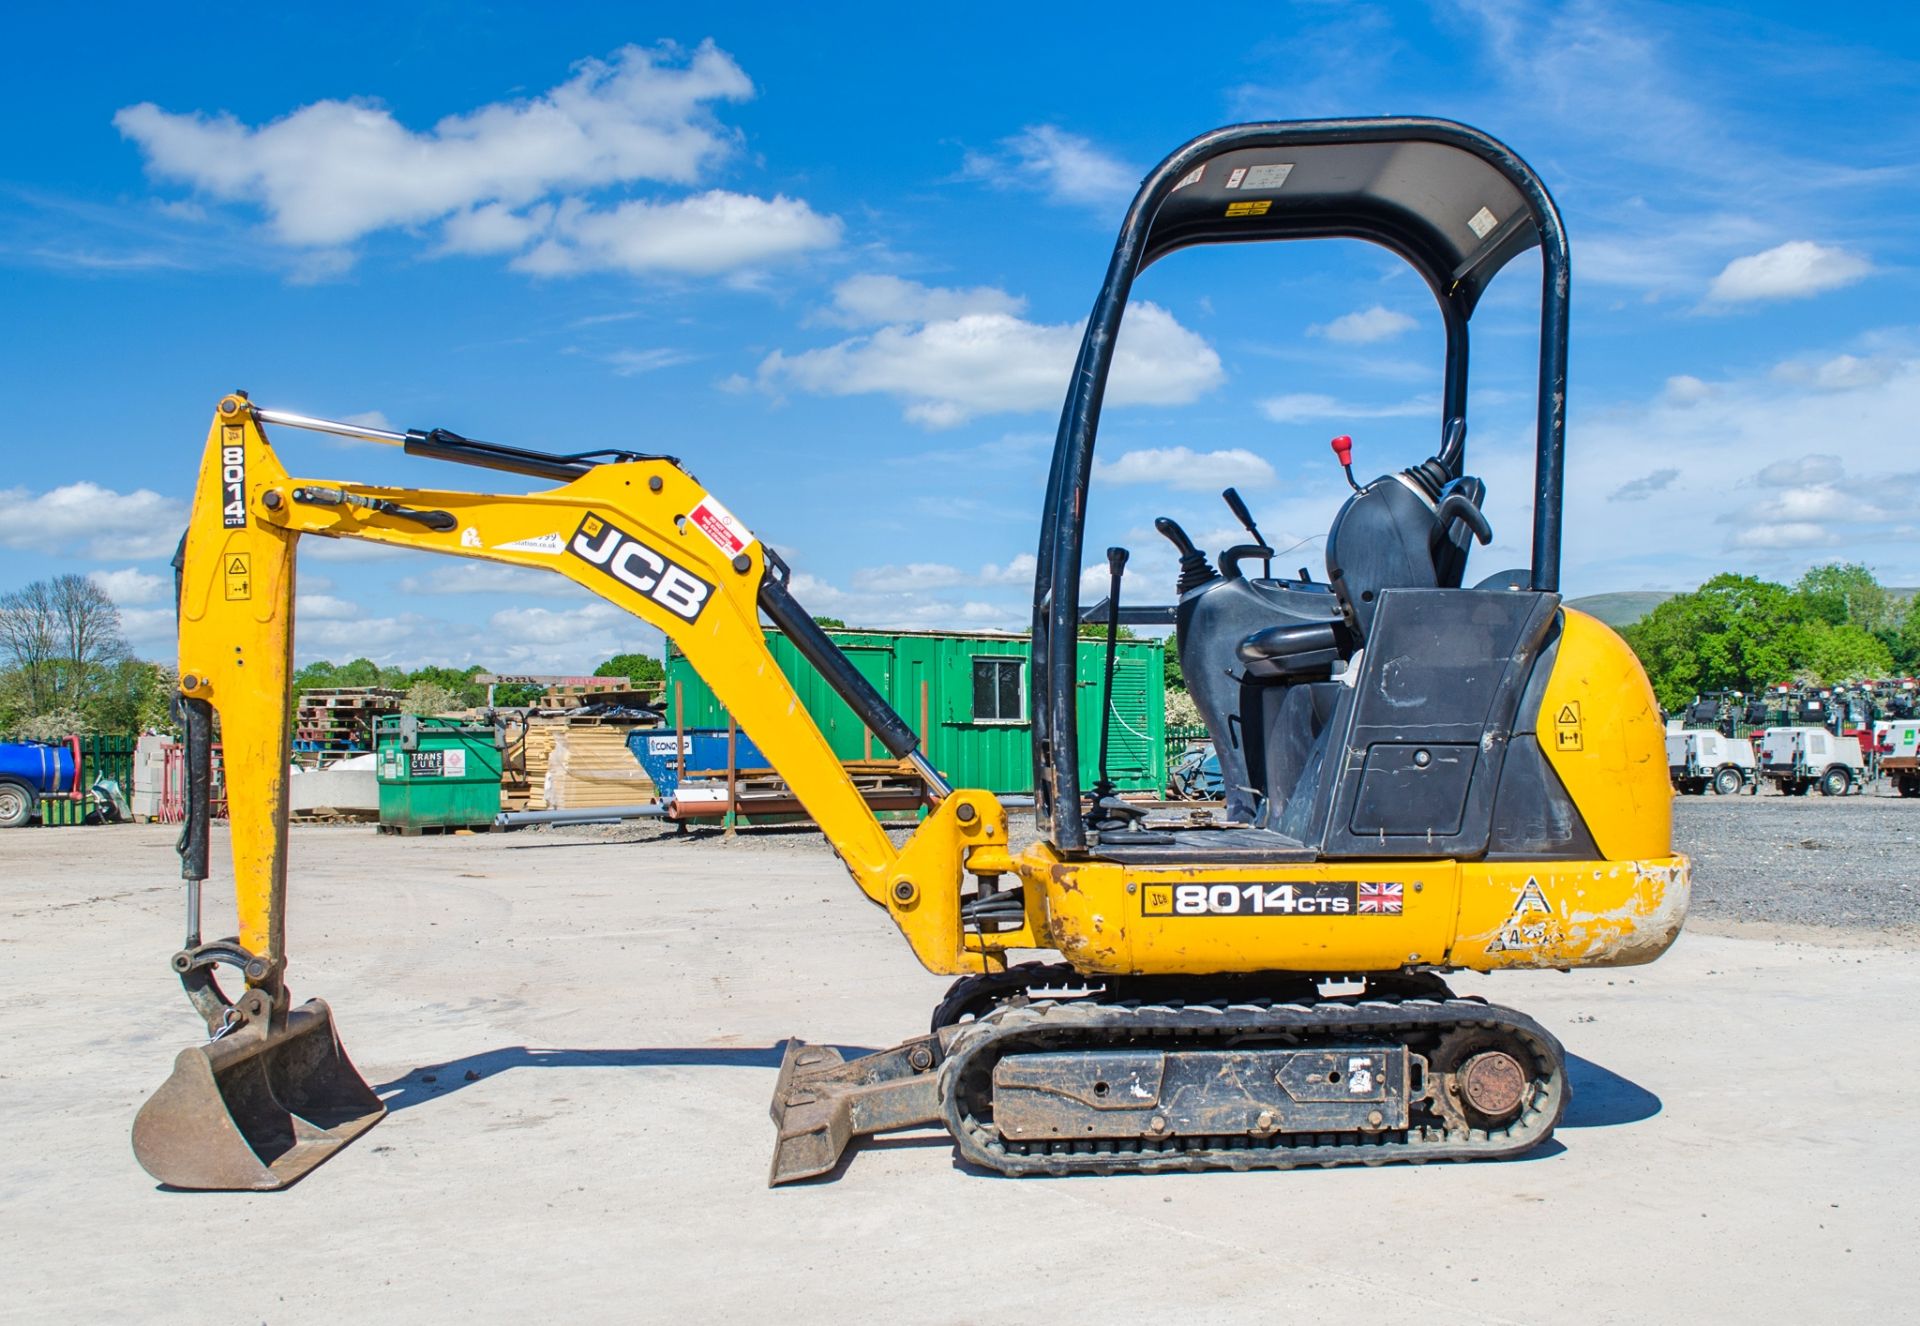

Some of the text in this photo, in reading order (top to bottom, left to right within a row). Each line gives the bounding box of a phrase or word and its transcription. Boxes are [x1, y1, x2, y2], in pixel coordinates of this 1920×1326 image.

[223, 447, 245, 518] 8014
[573, 529, 708, 618] JCB
[411, 752, 442, 761] TRANS
[411, 760, 442, 768] CUBE
